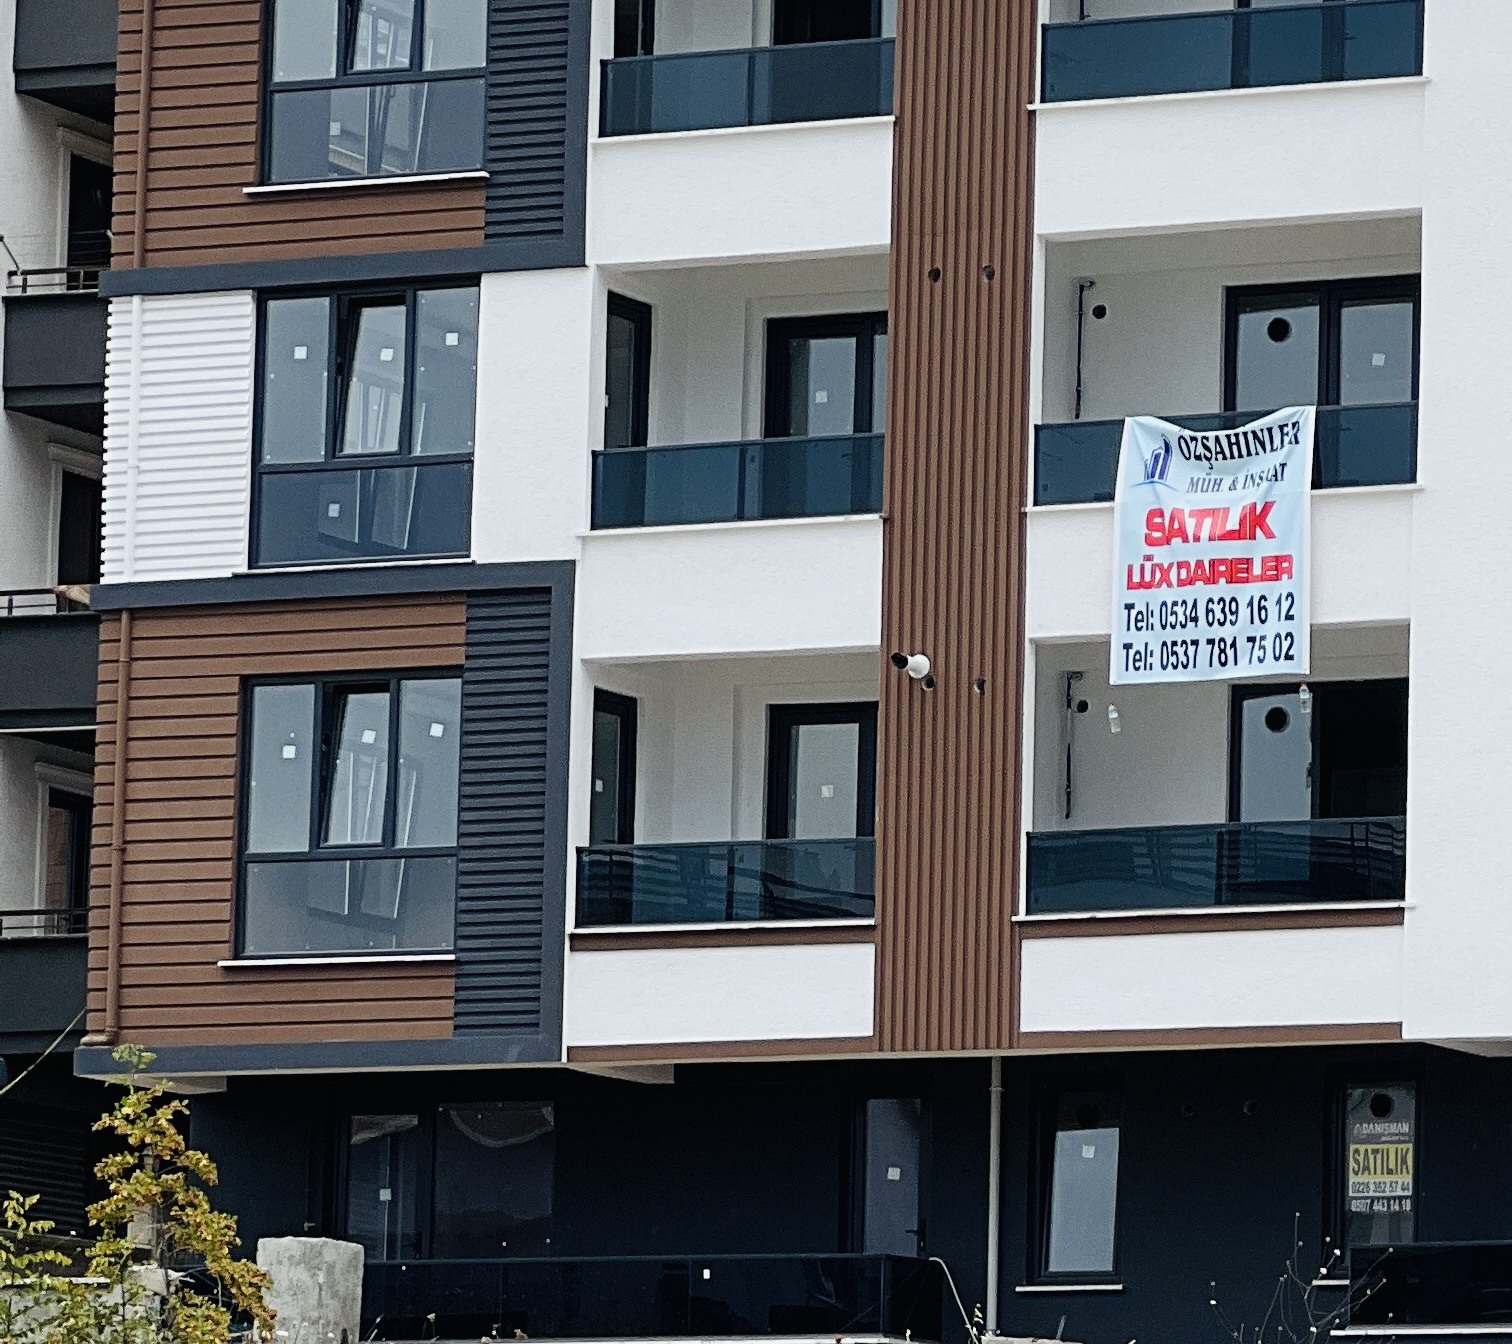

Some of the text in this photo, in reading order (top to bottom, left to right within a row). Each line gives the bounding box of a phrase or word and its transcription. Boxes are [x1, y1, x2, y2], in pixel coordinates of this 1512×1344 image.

[1228, 480, 1239, 492] &
[1144, 500, 1277, 547] SATILIK
[1126, 554, 1175, 591] LÜX
[1123, 591, 1296, 632] Tel: 0534 639 16 12
[1122, 631, 1296, 672] Tel: 0537 781 75 02
[1351, 1147, 1411, 1177] SATILIK
